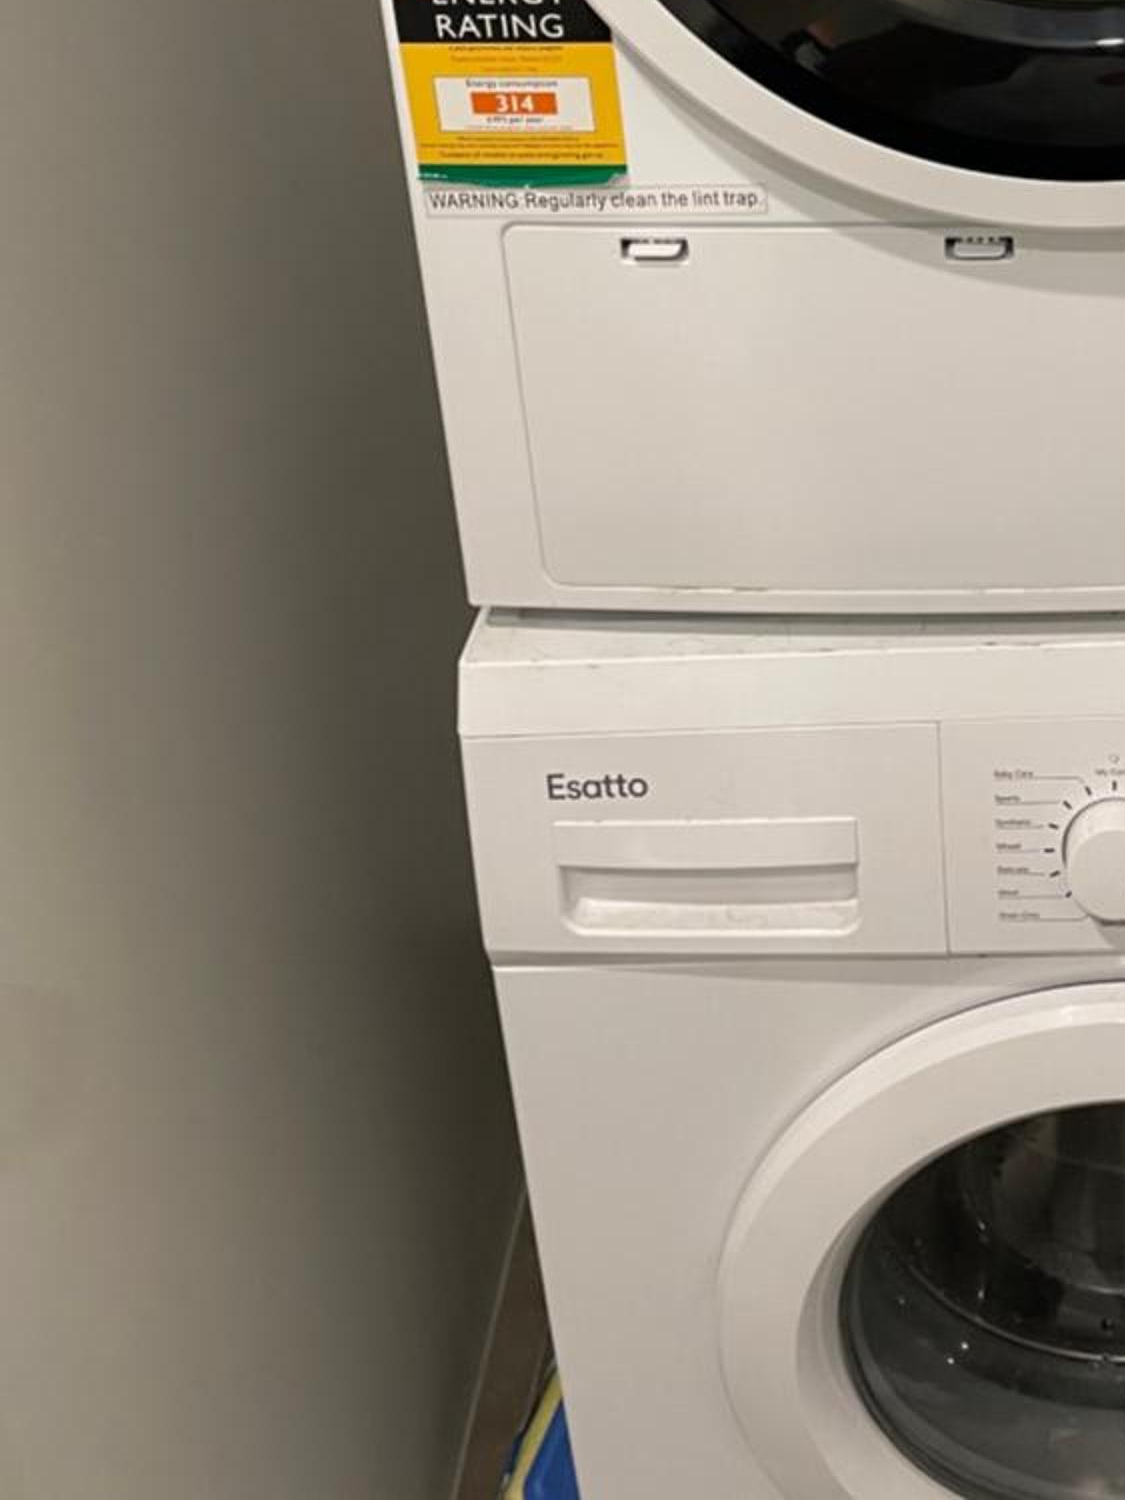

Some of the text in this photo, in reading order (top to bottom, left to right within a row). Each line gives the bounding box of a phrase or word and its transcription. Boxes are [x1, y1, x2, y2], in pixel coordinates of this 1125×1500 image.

[435, 14, 565, 40] RATING
[495, 93, 536, 114] 314
[525, 190, 606, 212] Regularly
[611, 190, 657, 208] clean
[661, 190, 688, 207] the
[692, 189, 719, 206] lint
[724, 190, 759, 208] trap
[547, 772, 648, 800] Esatto
